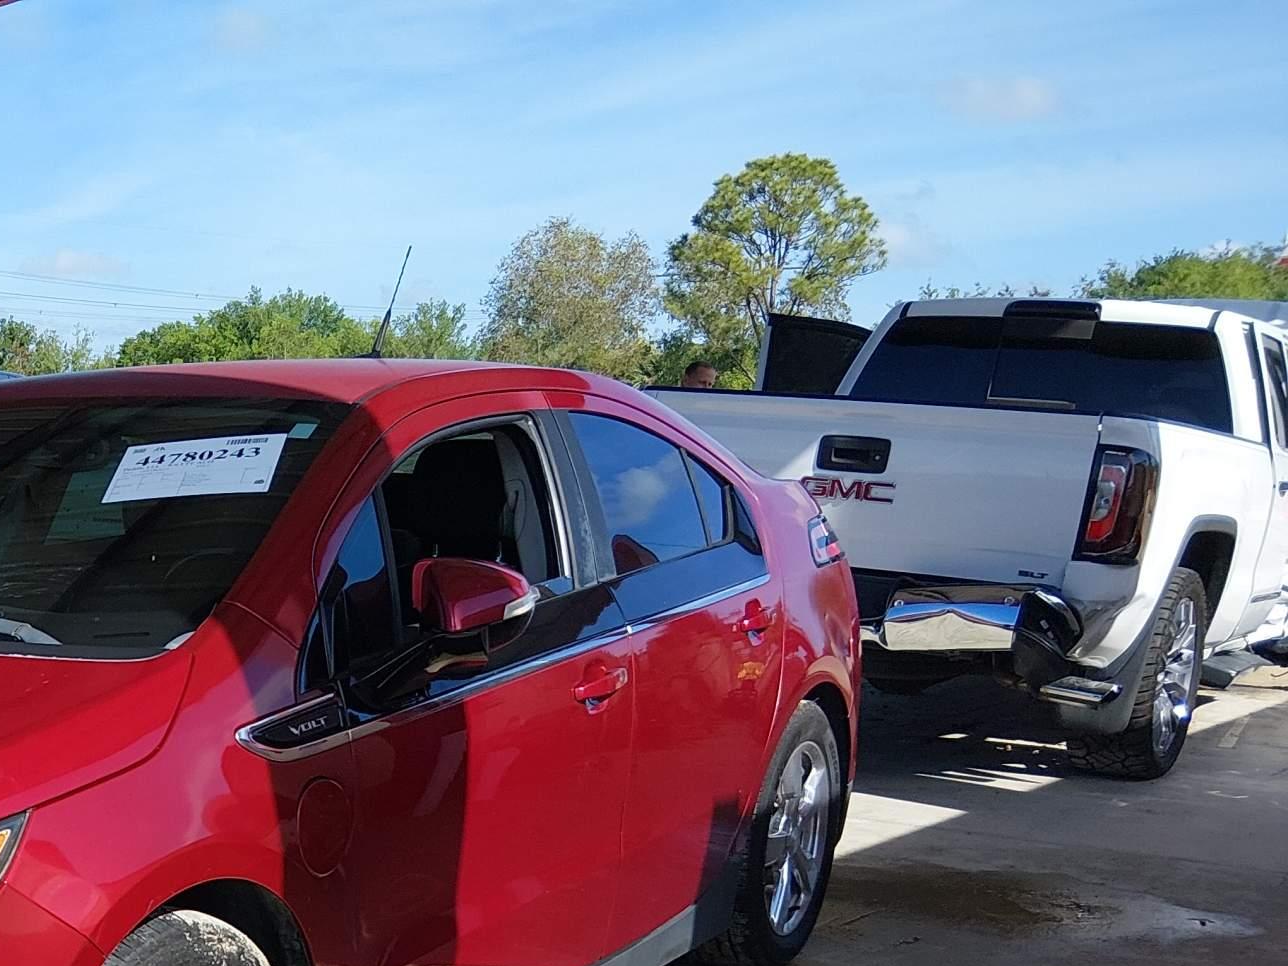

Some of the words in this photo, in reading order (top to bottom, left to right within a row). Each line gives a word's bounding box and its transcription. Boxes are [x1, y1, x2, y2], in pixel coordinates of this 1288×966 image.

[135, 446, 261, 467] 44780243
[800, 475, 896, 504] GMC
[1017, 569, 1049, 580] SLT
[288, 715, 328, 736] VOLT
